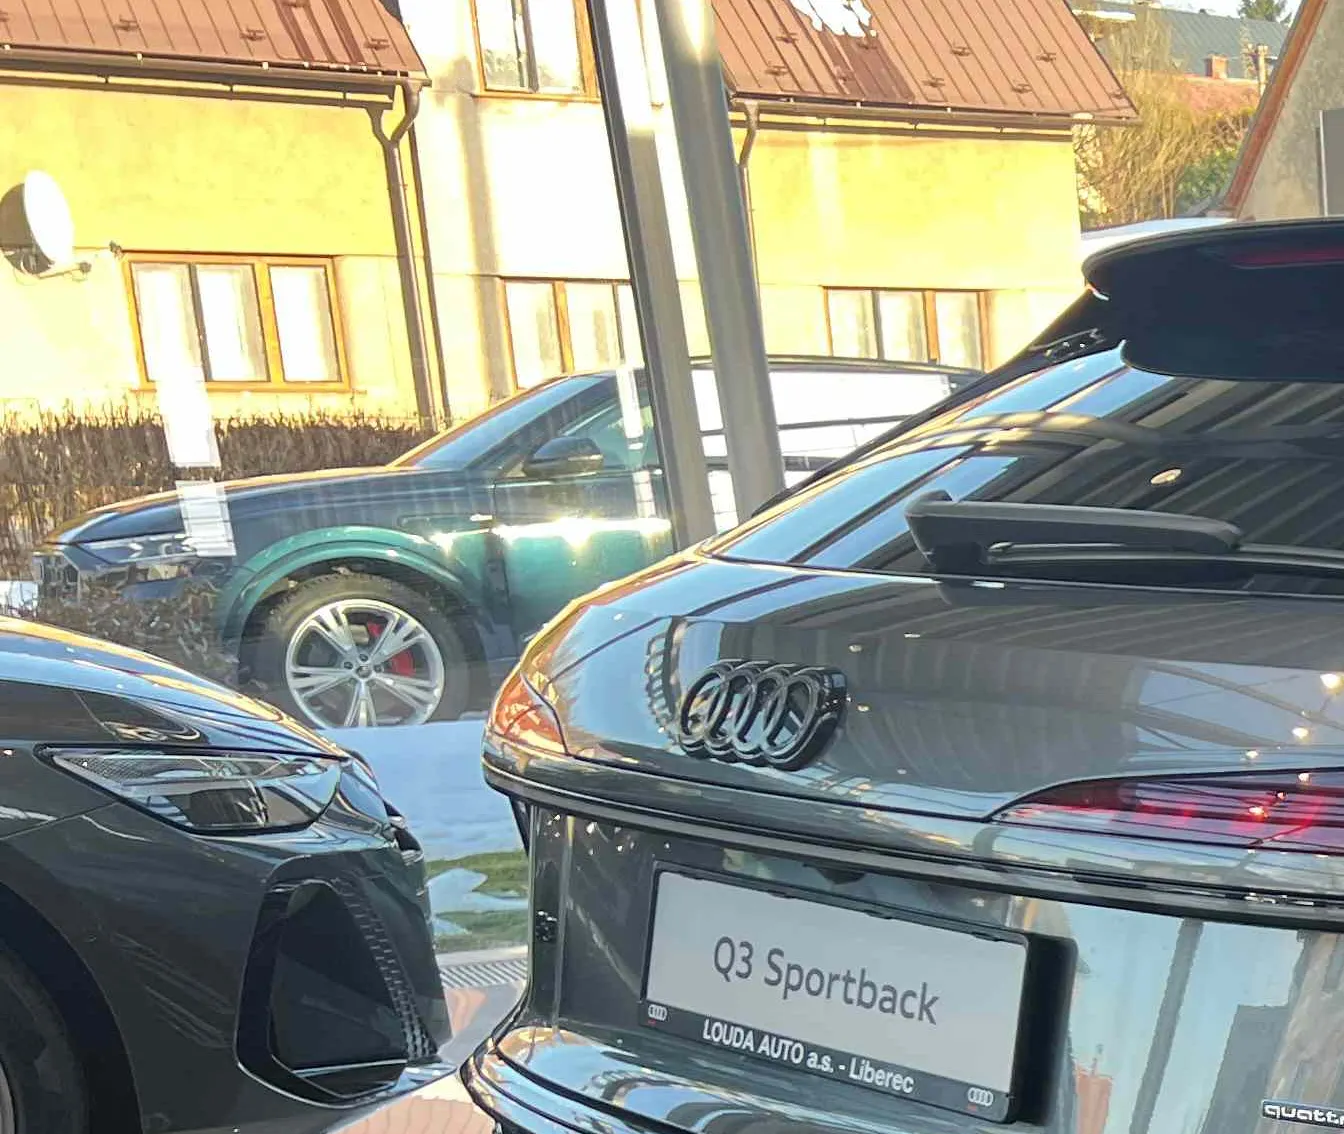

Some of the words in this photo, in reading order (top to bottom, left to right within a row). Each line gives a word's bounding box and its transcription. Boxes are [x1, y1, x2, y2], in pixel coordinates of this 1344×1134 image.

[714, 936, 754, 982] Q3
[764, 948, 939, 1025] Sportback
[702, 1019, 755, 1052] LOUDA
[757, 1034, 805, 1065] AUTO
[806, 1050, 834, 1073] a.s.
[848, 1058, 914, 1094] Liberec
